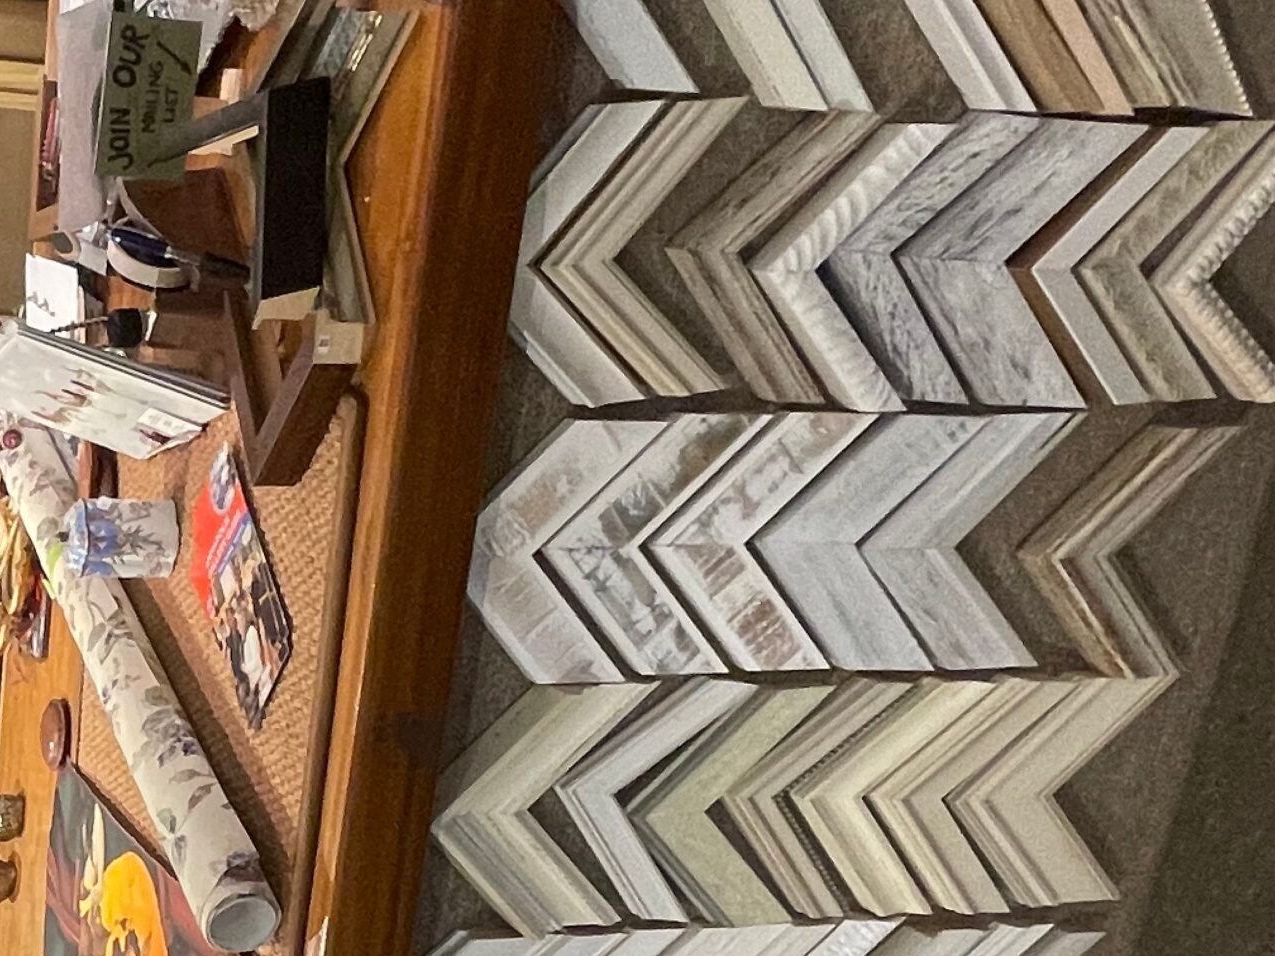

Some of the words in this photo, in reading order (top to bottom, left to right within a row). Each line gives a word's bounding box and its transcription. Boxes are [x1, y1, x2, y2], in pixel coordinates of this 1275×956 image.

[112, 25, 150, 88] OUR
[141, 60, 163, 133] MAILING
[163, 85, 179, 123] LIST
[107, 107, 134, 171] JOIN
